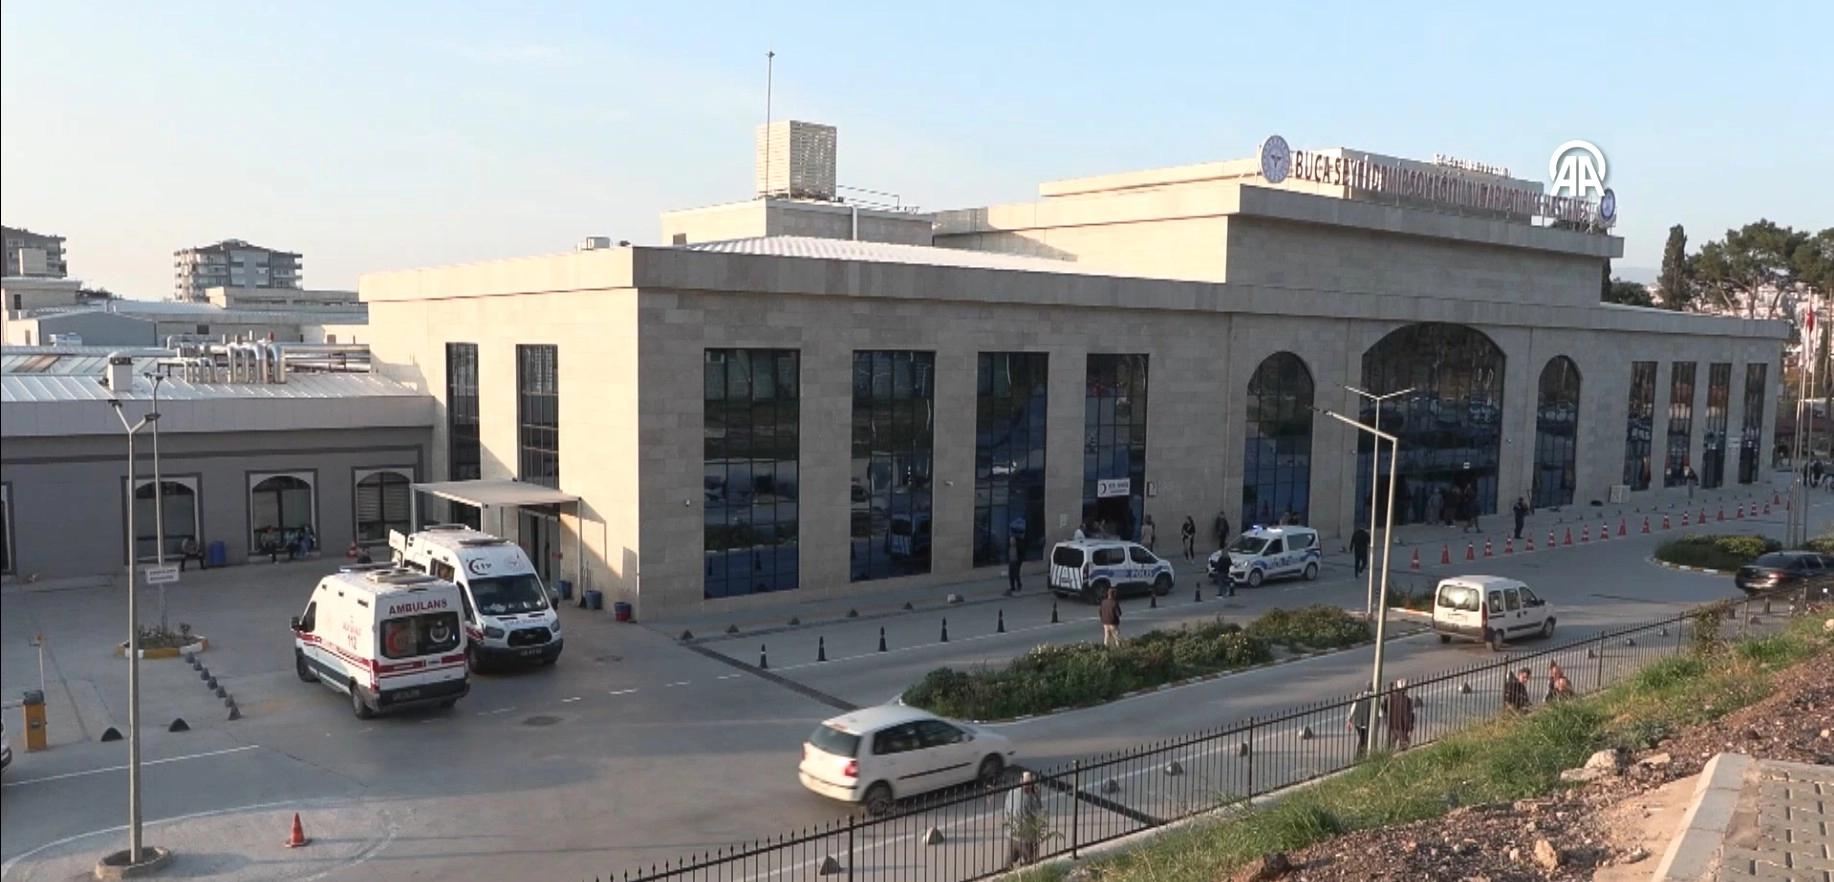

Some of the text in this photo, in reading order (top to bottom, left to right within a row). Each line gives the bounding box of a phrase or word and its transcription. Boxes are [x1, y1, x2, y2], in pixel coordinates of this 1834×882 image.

[1295, 150, 1331, 184] BUCA
[1369, 160, 1431, 199] DEMİRSOY
[388, 599, 448, 616] AMBULANS
[347, 634, 357, 650] 112
